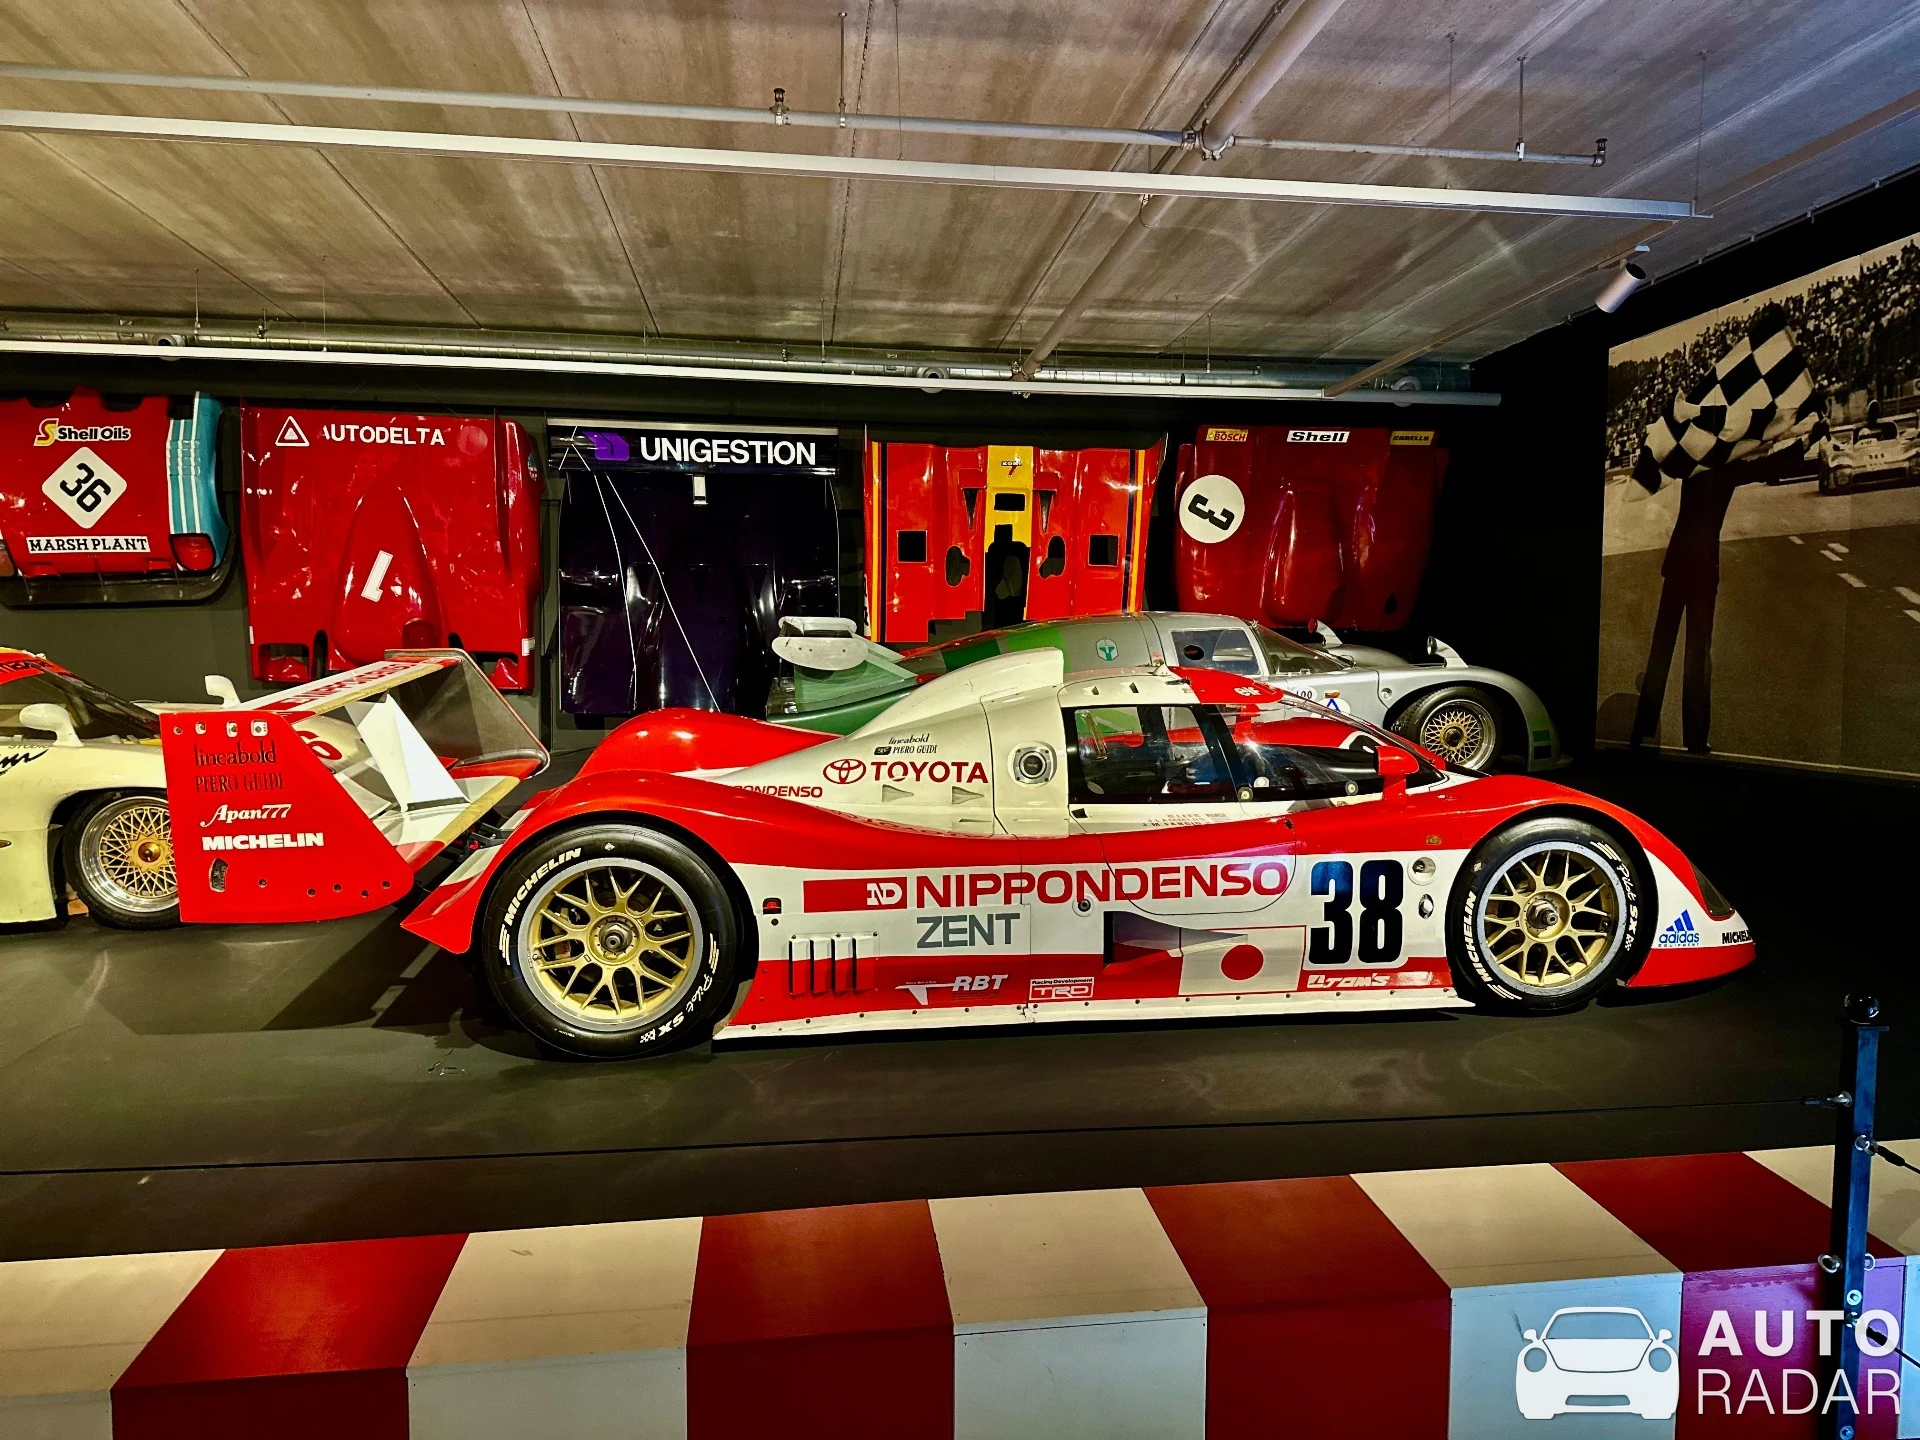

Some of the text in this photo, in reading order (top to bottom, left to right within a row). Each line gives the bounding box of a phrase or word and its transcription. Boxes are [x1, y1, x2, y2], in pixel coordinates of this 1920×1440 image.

[58, 427, 130, 440] Shell Oils
[1214, 433, 1247, 441] BOSCH
[1290, 431, 1346, 442] Shell
[640, 436, 816, 465] UNIGESTION
[59, 462, 112, 513] 36
[1187, 493, 1235, 531] 3
[29, 538, 147, 552] MARSH PLANT
[888, 732, 931, 745] lineabold
[892, 745, 915, 754] PIERO
[916, 744, 938, 754] GUIDI
[193, 740, 278, 767] lineabold
[195, 772, 284, 793] PIERO GUIDI
[874, 760, 989, 784] TOYOTA
[199, 803, 293, 828] Apan777
[201, 832, 325, 851] MICHELIN
[504, 847, 582, 927] MICHELIN
[916, 862, 1288, 909] NIPPONDENSO
[1616, 863, 1640, 932] Pilot SX
[1308, 859, 1404, 965] 38
[916, 912, 1021, 949] ZENT
[1463, 891, 1493, 985] MICHELIN
[1658, 930, 1700, 944] adidas
[952, 974, 1009, 992] RBT
[1033, 985, 1090, 999] TRD
[657, 974, 713, 1038] Pilot SX
